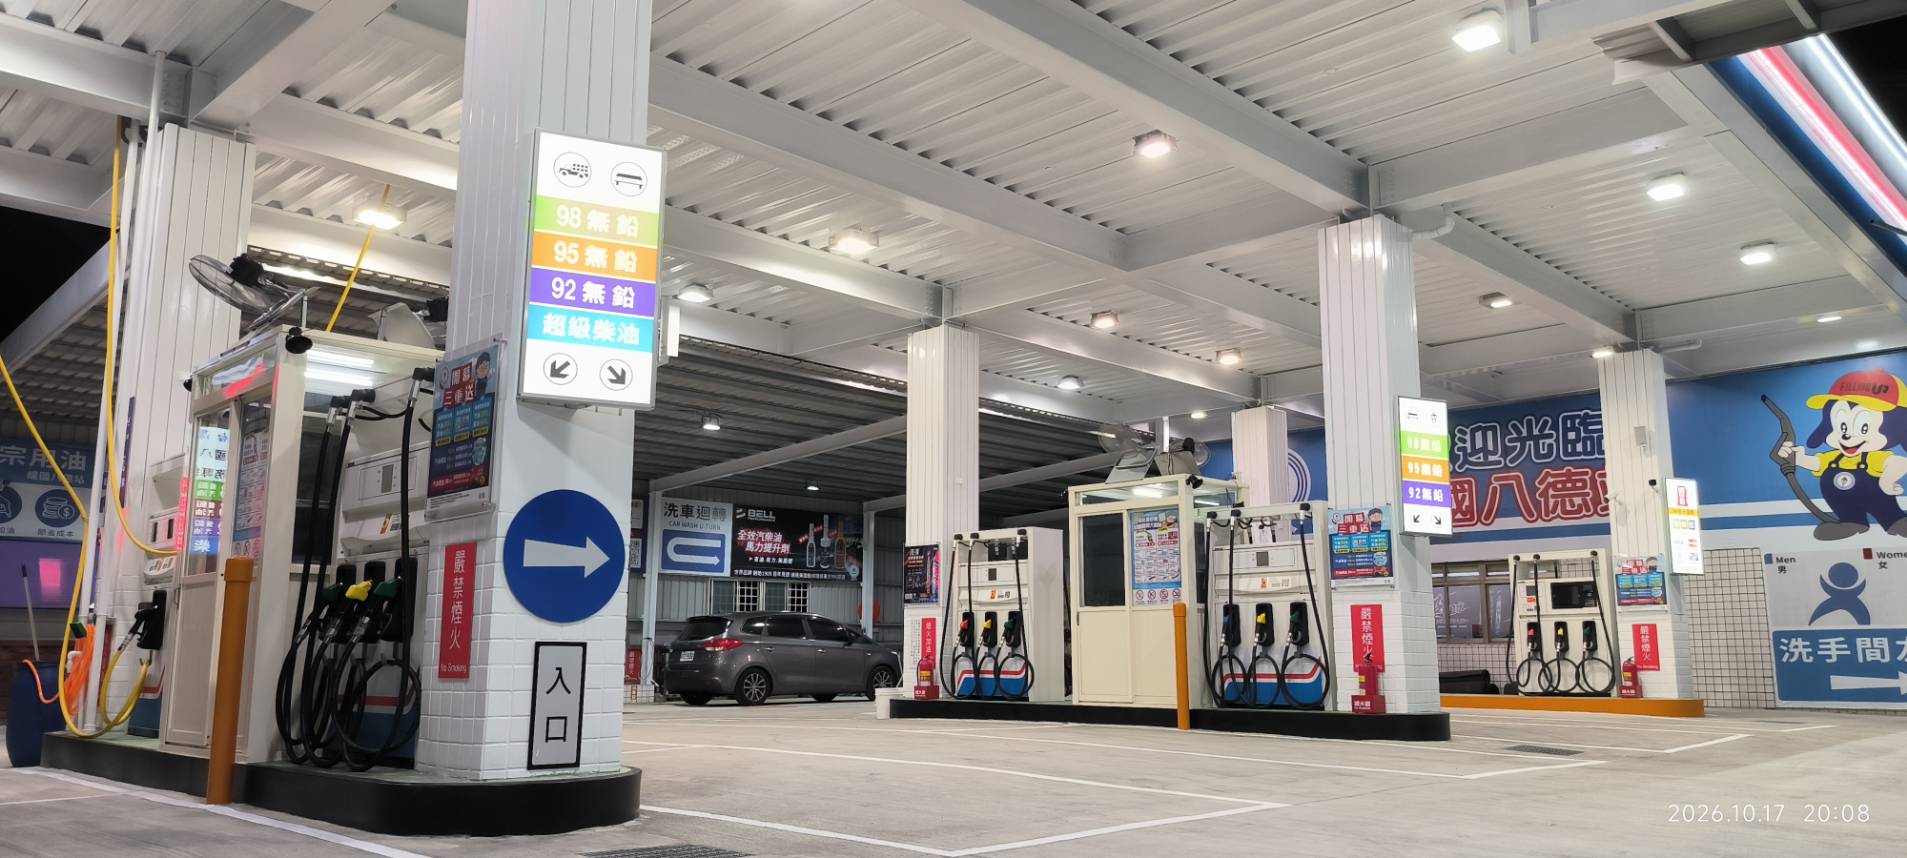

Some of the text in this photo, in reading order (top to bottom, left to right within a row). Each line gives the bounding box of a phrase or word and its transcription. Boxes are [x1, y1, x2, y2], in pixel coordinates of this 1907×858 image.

[542, 313, 640, 345] 超級柴油
[1450, 410, 1605, 472] 迎光臨
[663, 502, 727, 522] 洗車迴轉
[747, 509, 776, 519] BELL
[681, 521, 699, 529] WASH
[1775, 556, 1797, 564] Men
[1878, 561, 1888, 570] 女
[1777, 565, 1787, 574] 男
[449, 550, 466, 649] 嚴禁煙火
[447, 662, 467, 673] Smoking
[545, 667, 571, 743] 入口
